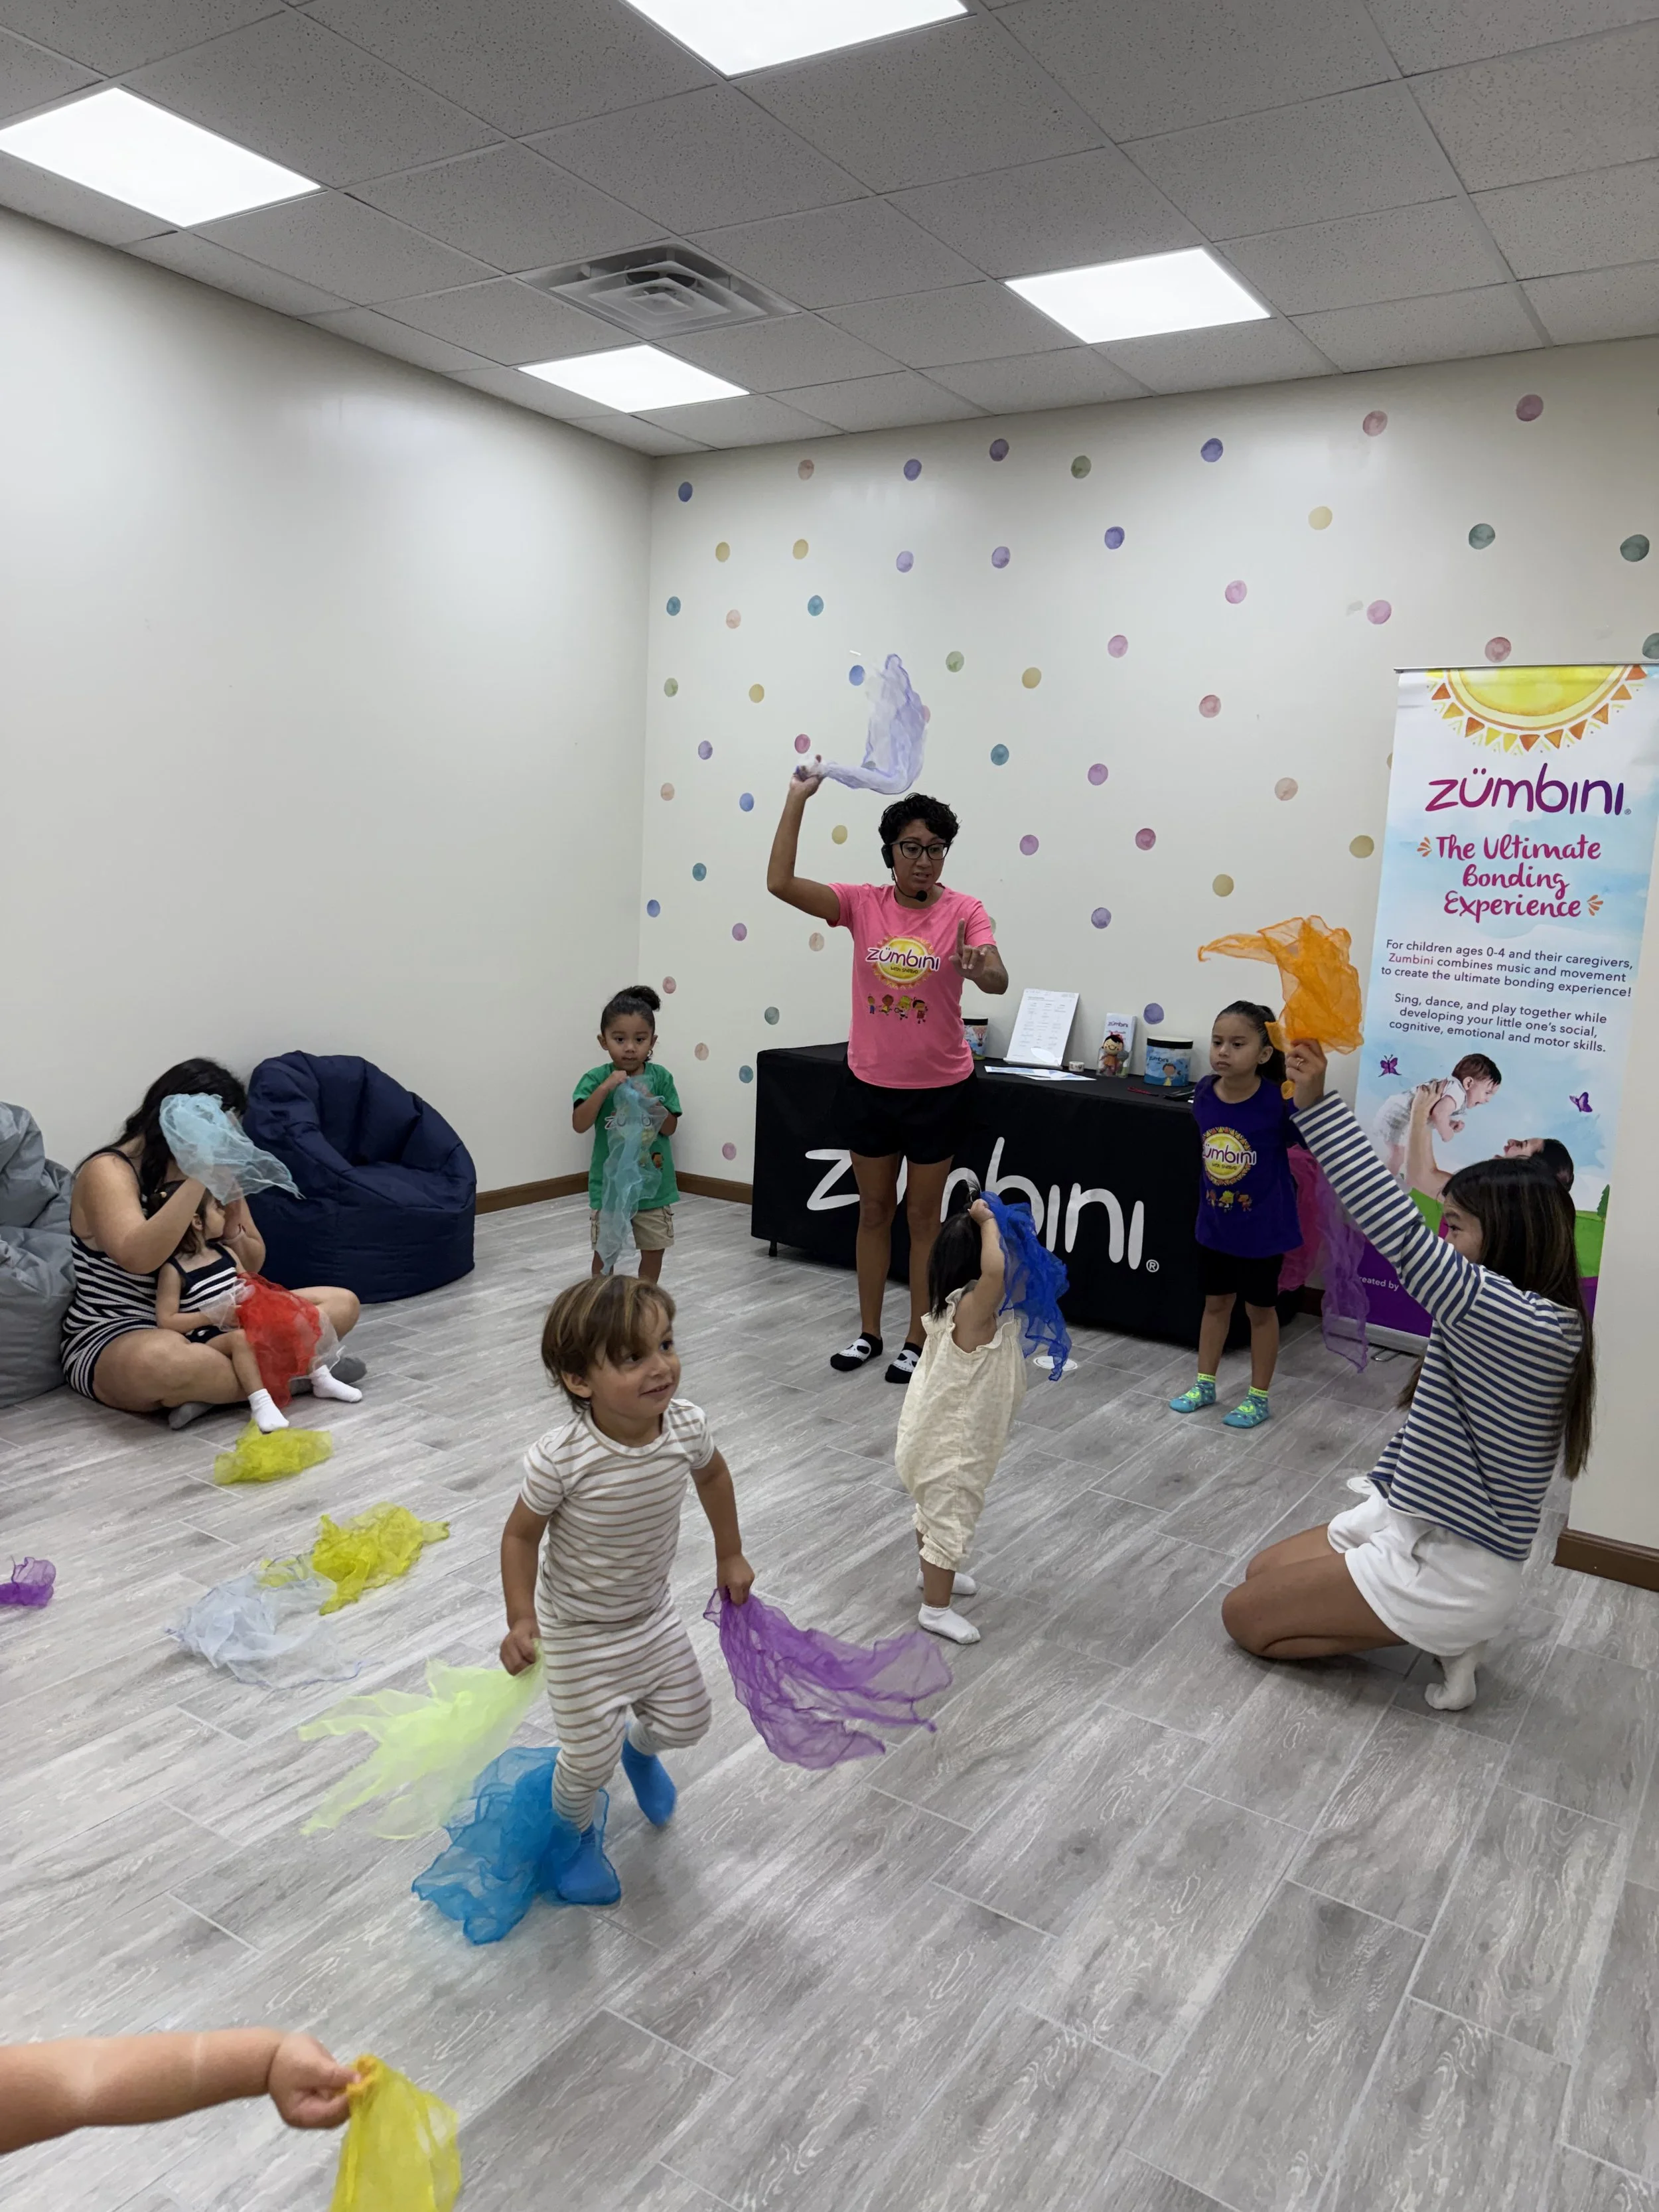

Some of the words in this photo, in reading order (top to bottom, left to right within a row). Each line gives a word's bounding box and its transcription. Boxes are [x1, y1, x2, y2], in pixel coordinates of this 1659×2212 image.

[1436, 834, 1476, 861] The
[1483, 834, 1601, 860] Ultimate
[1463, 862, 1570, 900] Bonding
[1444, 891, 1581, 923] Experience
[1386, 939, 1404, 950] For
[1406, 941, 1452, 953] children
[1456, 947, 1483, 957] ages
[1486, 946, 1505, 957] 0-4
[1508, 950, 1531, 960] and
[1535, 950, 1563, 962] their
[1565, 956, 1633, 970] caregivers,
[1388, 953, 1434, 965] Zumbini
[1437, 958, 1492, 970] combines
[1496, 964, 1530, 974] music
[1534, 966, 1557, 976] and
[1560, 969, 1626, 982] movement
[1382, 966, 1392, 975] to
[1394, 968, 1429, 978] create
[1432, 970, 1451, 980] the
[1454, 972, 1500, 985] ultimate
[1504, 976, 1554, 992] bonding
[1558, 984, 1631, 997] experience!
[1395, 993, 1421, 1006] Sing,
[1425, 996, 1463, 1010] dance,
[1467, 1001, 1488, 1011] and
[1492, 1003, 1516, 1016] play
[1520, 1006, 1571, 1019] together
[1575, 1011, 1607, 1023] while
[1400, 1007, 1464, 1024] developing
[1467, 1016, 1493, 1025] your
[1496, 1016, 1522, 1028] little
[1559, 1026, 1597, 1038] social,
[1390, 1021, 1443, 1035] cognitive,
[1447, 1027, 1505, 1040] emotional
[1508, 1033, 1530, 1043] and
[1534, 1037, 1570, 1047] motor
[1573, 1039, 1606, 1052] skills.
[1388, 1280, 1399, 1291] by
